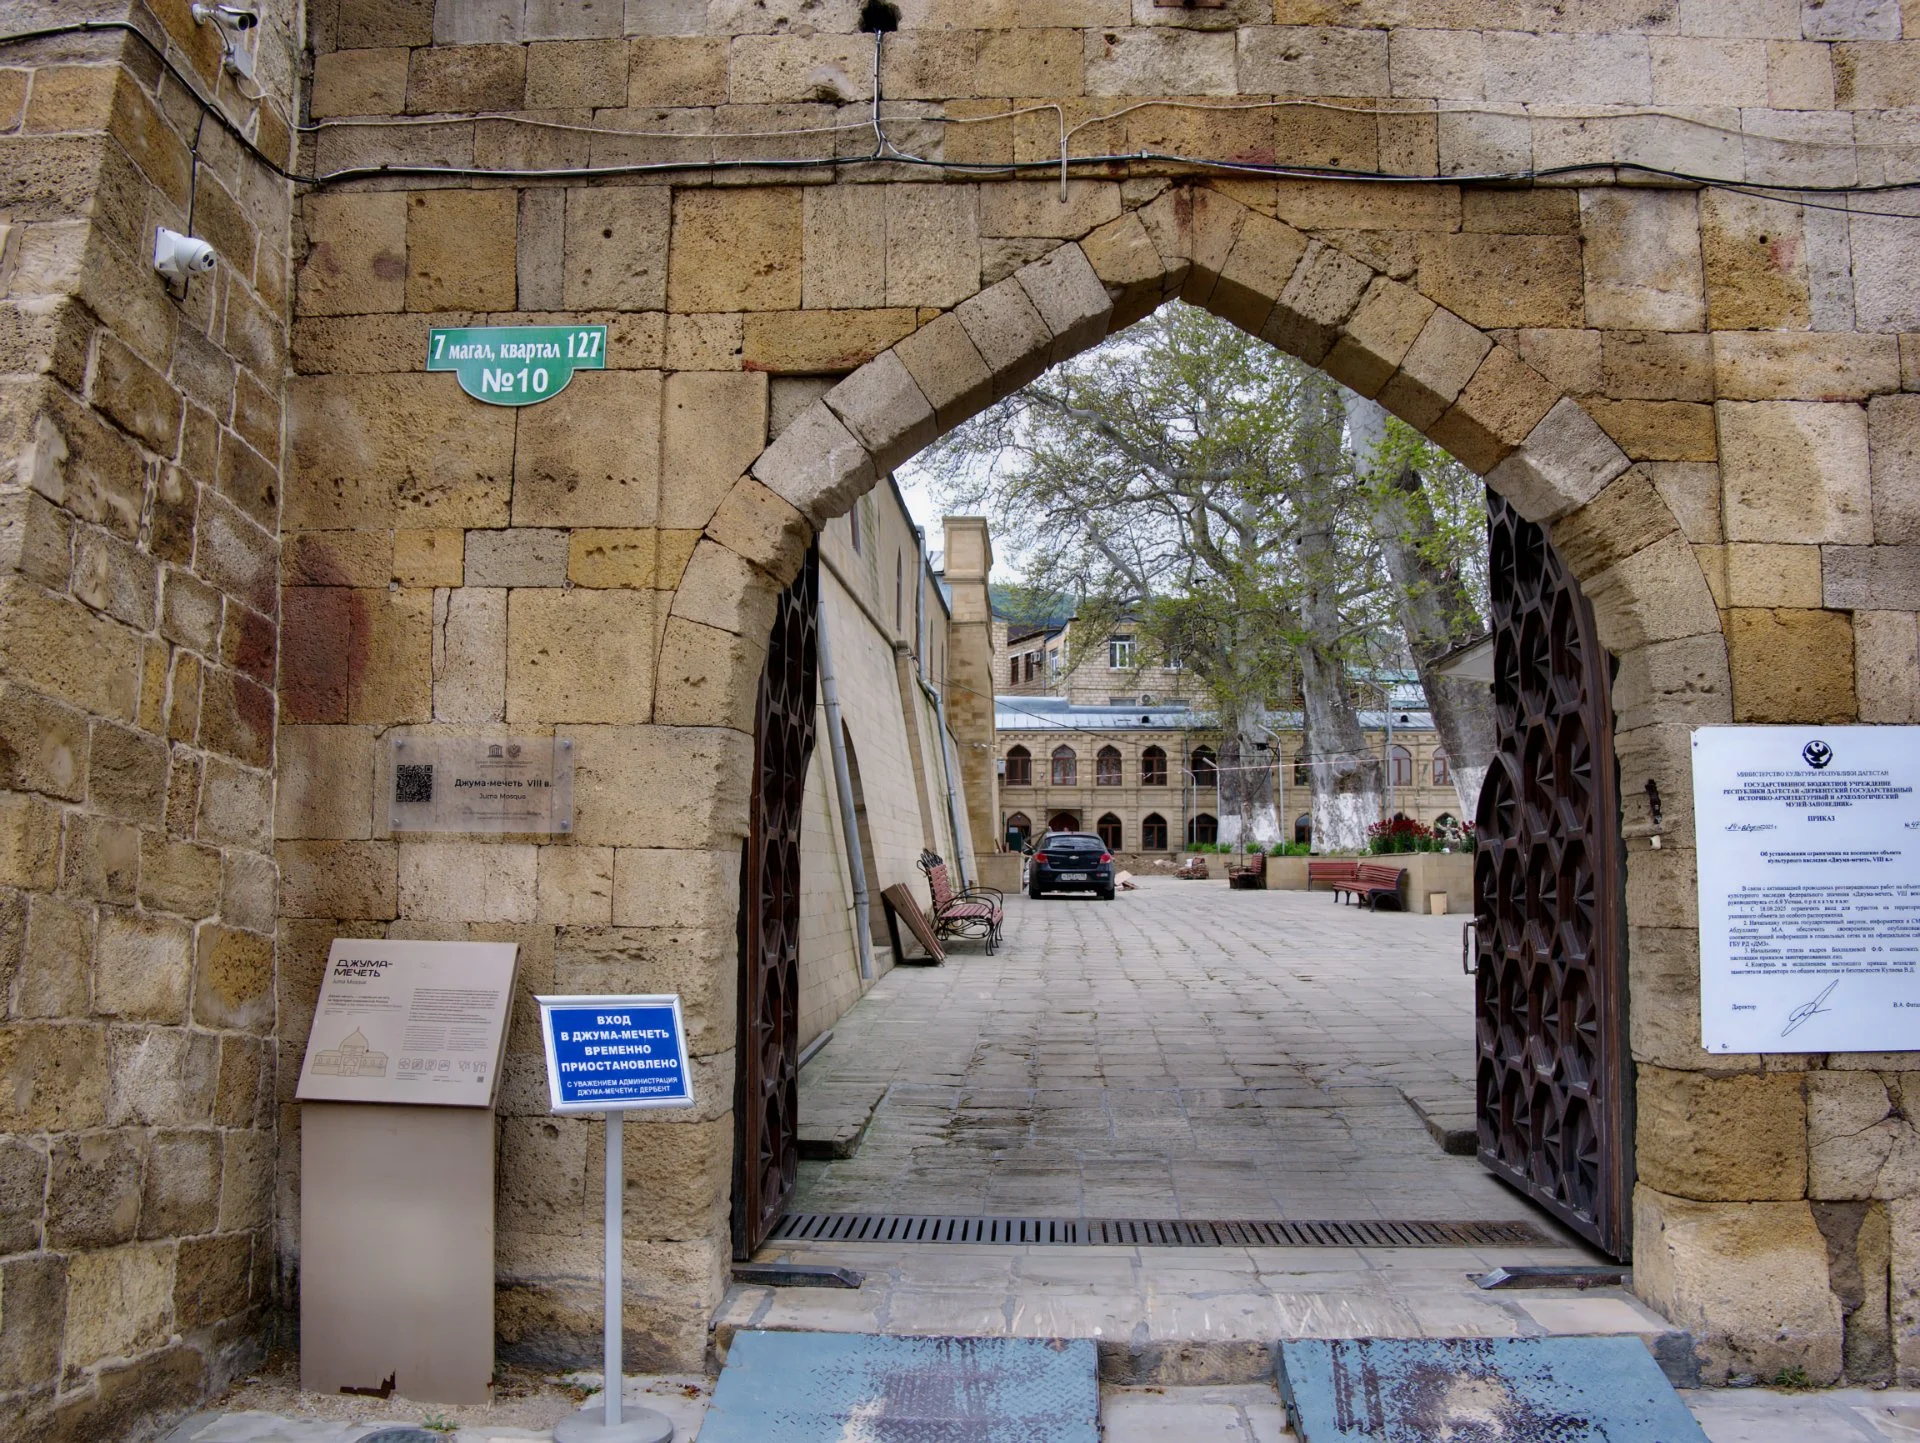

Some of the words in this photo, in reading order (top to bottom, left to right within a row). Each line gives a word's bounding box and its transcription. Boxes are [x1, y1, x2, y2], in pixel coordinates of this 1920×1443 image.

[434, 335, 446, 360] 7
[448, 343, 495, 361] магал,
[500, 343, 560, 363] квартал
[568, 332, 601, 358] 127
[482, 368, 548, 393] №10
[455, 779, 523, 788] Джума-мечеть
[527, 779, 542, 788] VIII
[336, 960, 393, 968] ДЖУМА-
[334, 968, 381, 977] МЕЧЕТЬ
[597, 1016, 631, 1025] ВХОД
[561, 1032, 569, 1041] В
[572, 1030, 669, 1042] ДЖУМА-МЕЧЕТЬ
[585, 1045, 651, 1056] ВРЕМЕННО
[562, 1059, 678, 1072] ПРИОСТАНОВЛЕНО
[574, 1079, 617, 1087] УВАЖЕНИЕМ
[619, 1077, 678, 1086] АДМИНИСТРАЦИЯ
[578, 1087, 633, 1096] ДЖУМА-МЕЧЕТИ
[640, 1086, 670, 1094] ДЕРБЕНТ
